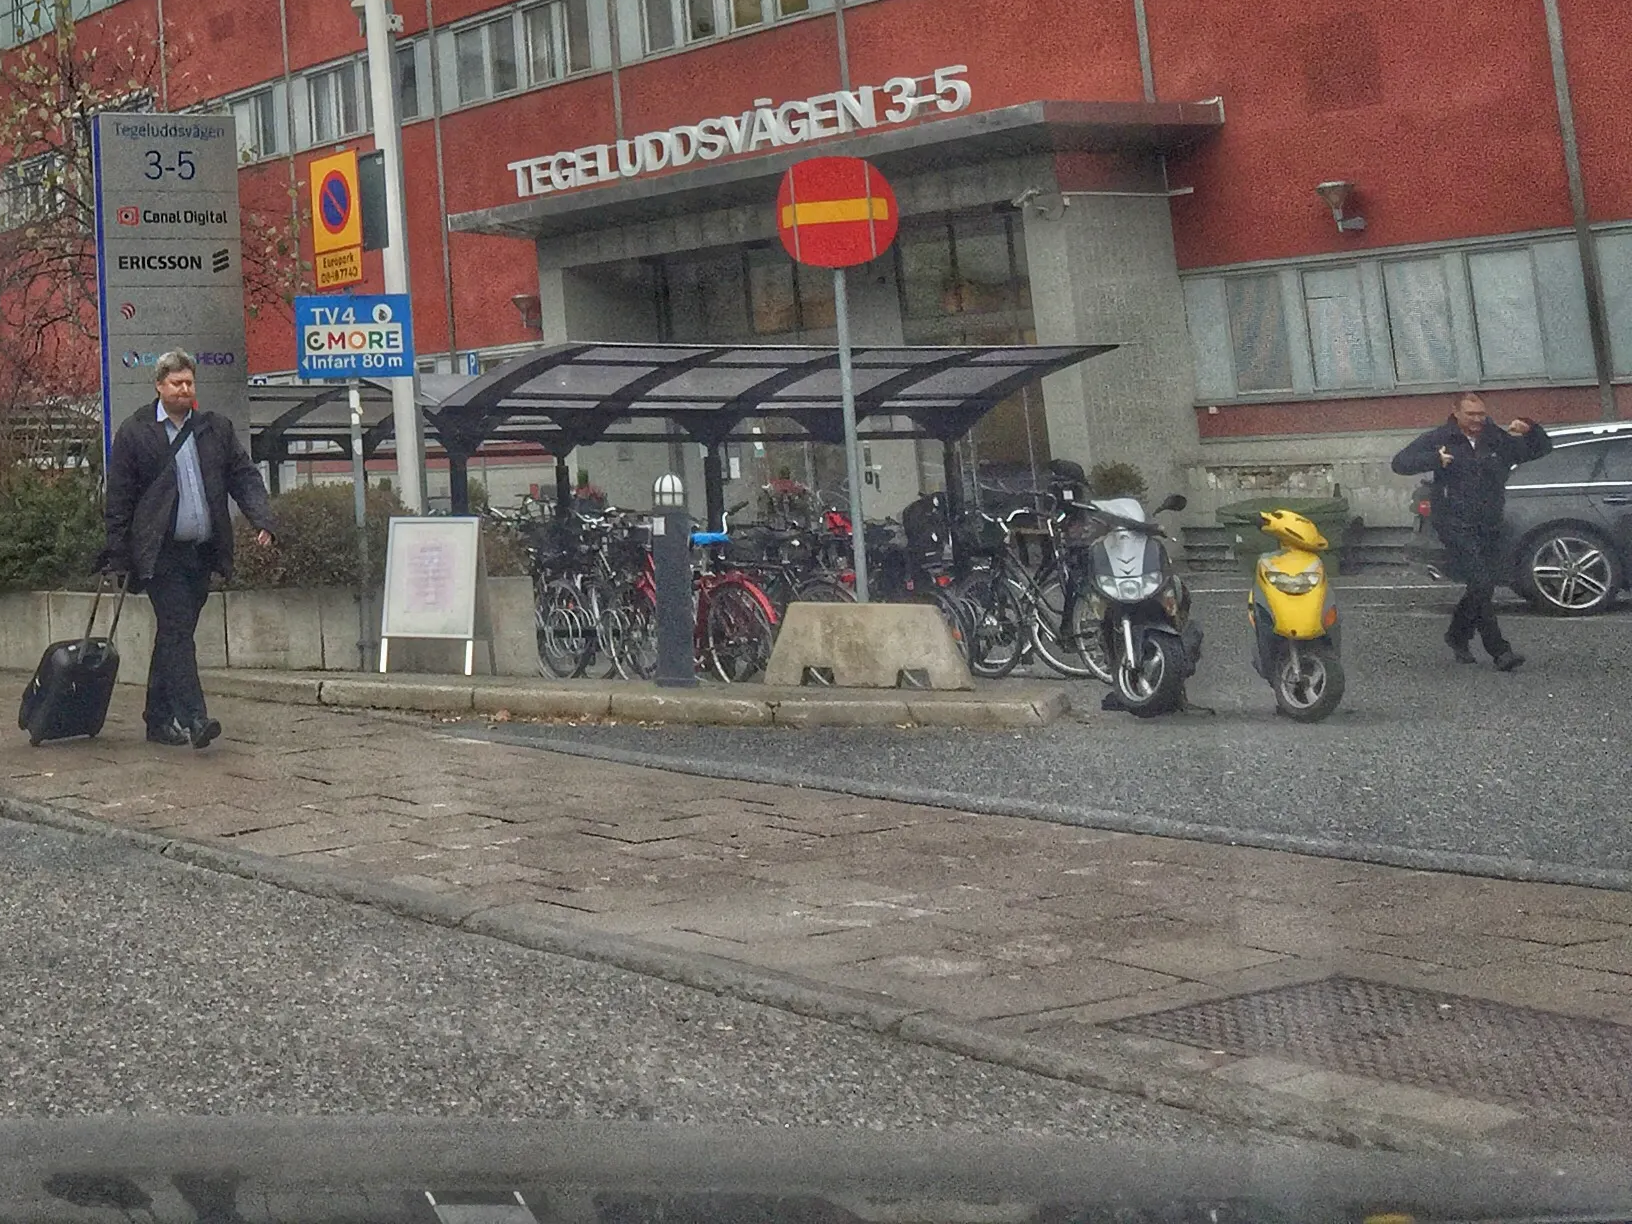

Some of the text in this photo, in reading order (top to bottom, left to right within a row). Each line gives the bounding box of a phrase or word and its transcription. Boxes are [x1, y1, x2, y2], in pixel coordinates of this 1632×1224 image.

[507, 65, 972, 198] TEGELUDDSVÄGEN 3-5
[144, 150, 196, 180] 3-5
[143, 210, 228, 226] Canal Digital
[118, 255, 202, 270] ERICSSON
[312, 354, 403, 370] Infart 80 m
